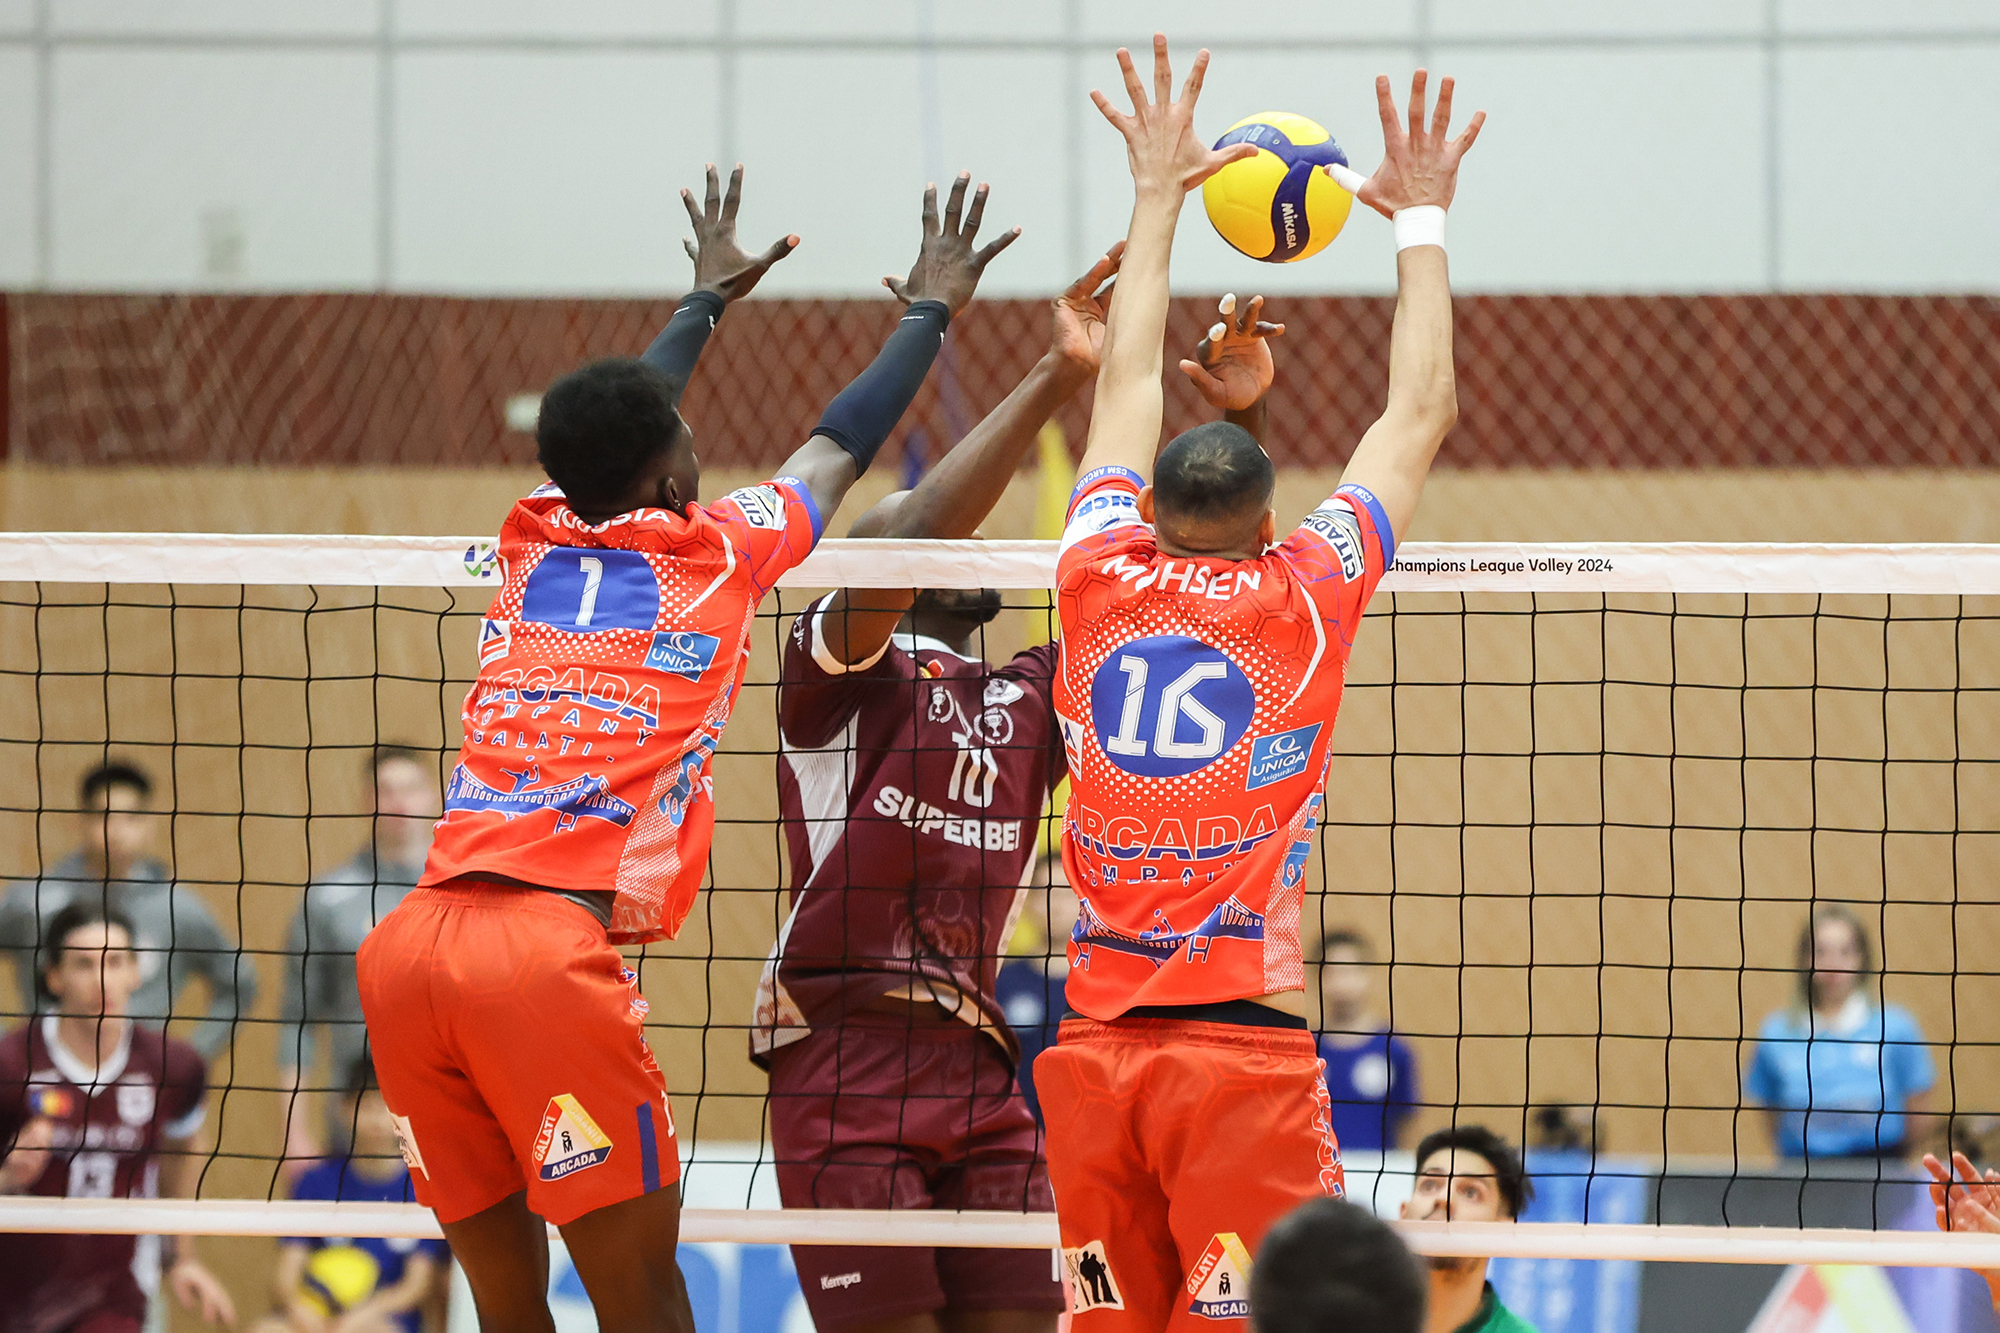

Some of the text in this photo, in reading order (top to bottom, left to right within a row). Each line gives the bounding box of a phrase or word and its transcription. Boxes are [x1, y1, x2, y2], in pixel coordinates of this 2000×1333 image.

[733, 489, 765, 527] CITA
[1471, 558, 1525, 576] League
[1529, 558, 1573, 576] Volley
[1577, 558, 1614, 573] 2024
[576, 556, 604, 626] 1
[651, 647, 704, 673] UNIQA
[474, 702, 656, 747] OMPANY
[1106, 654, 1228, 759] 16
[1252, 750, 1307, 777] UNIQA
[534, 1116, 557, 1162] GALATI
[551, 1152, 598, 1178] ARCADA
[820, 1270, 862, 1291] Kempa
[1186, 1252, 1218, 1296] GALATI
